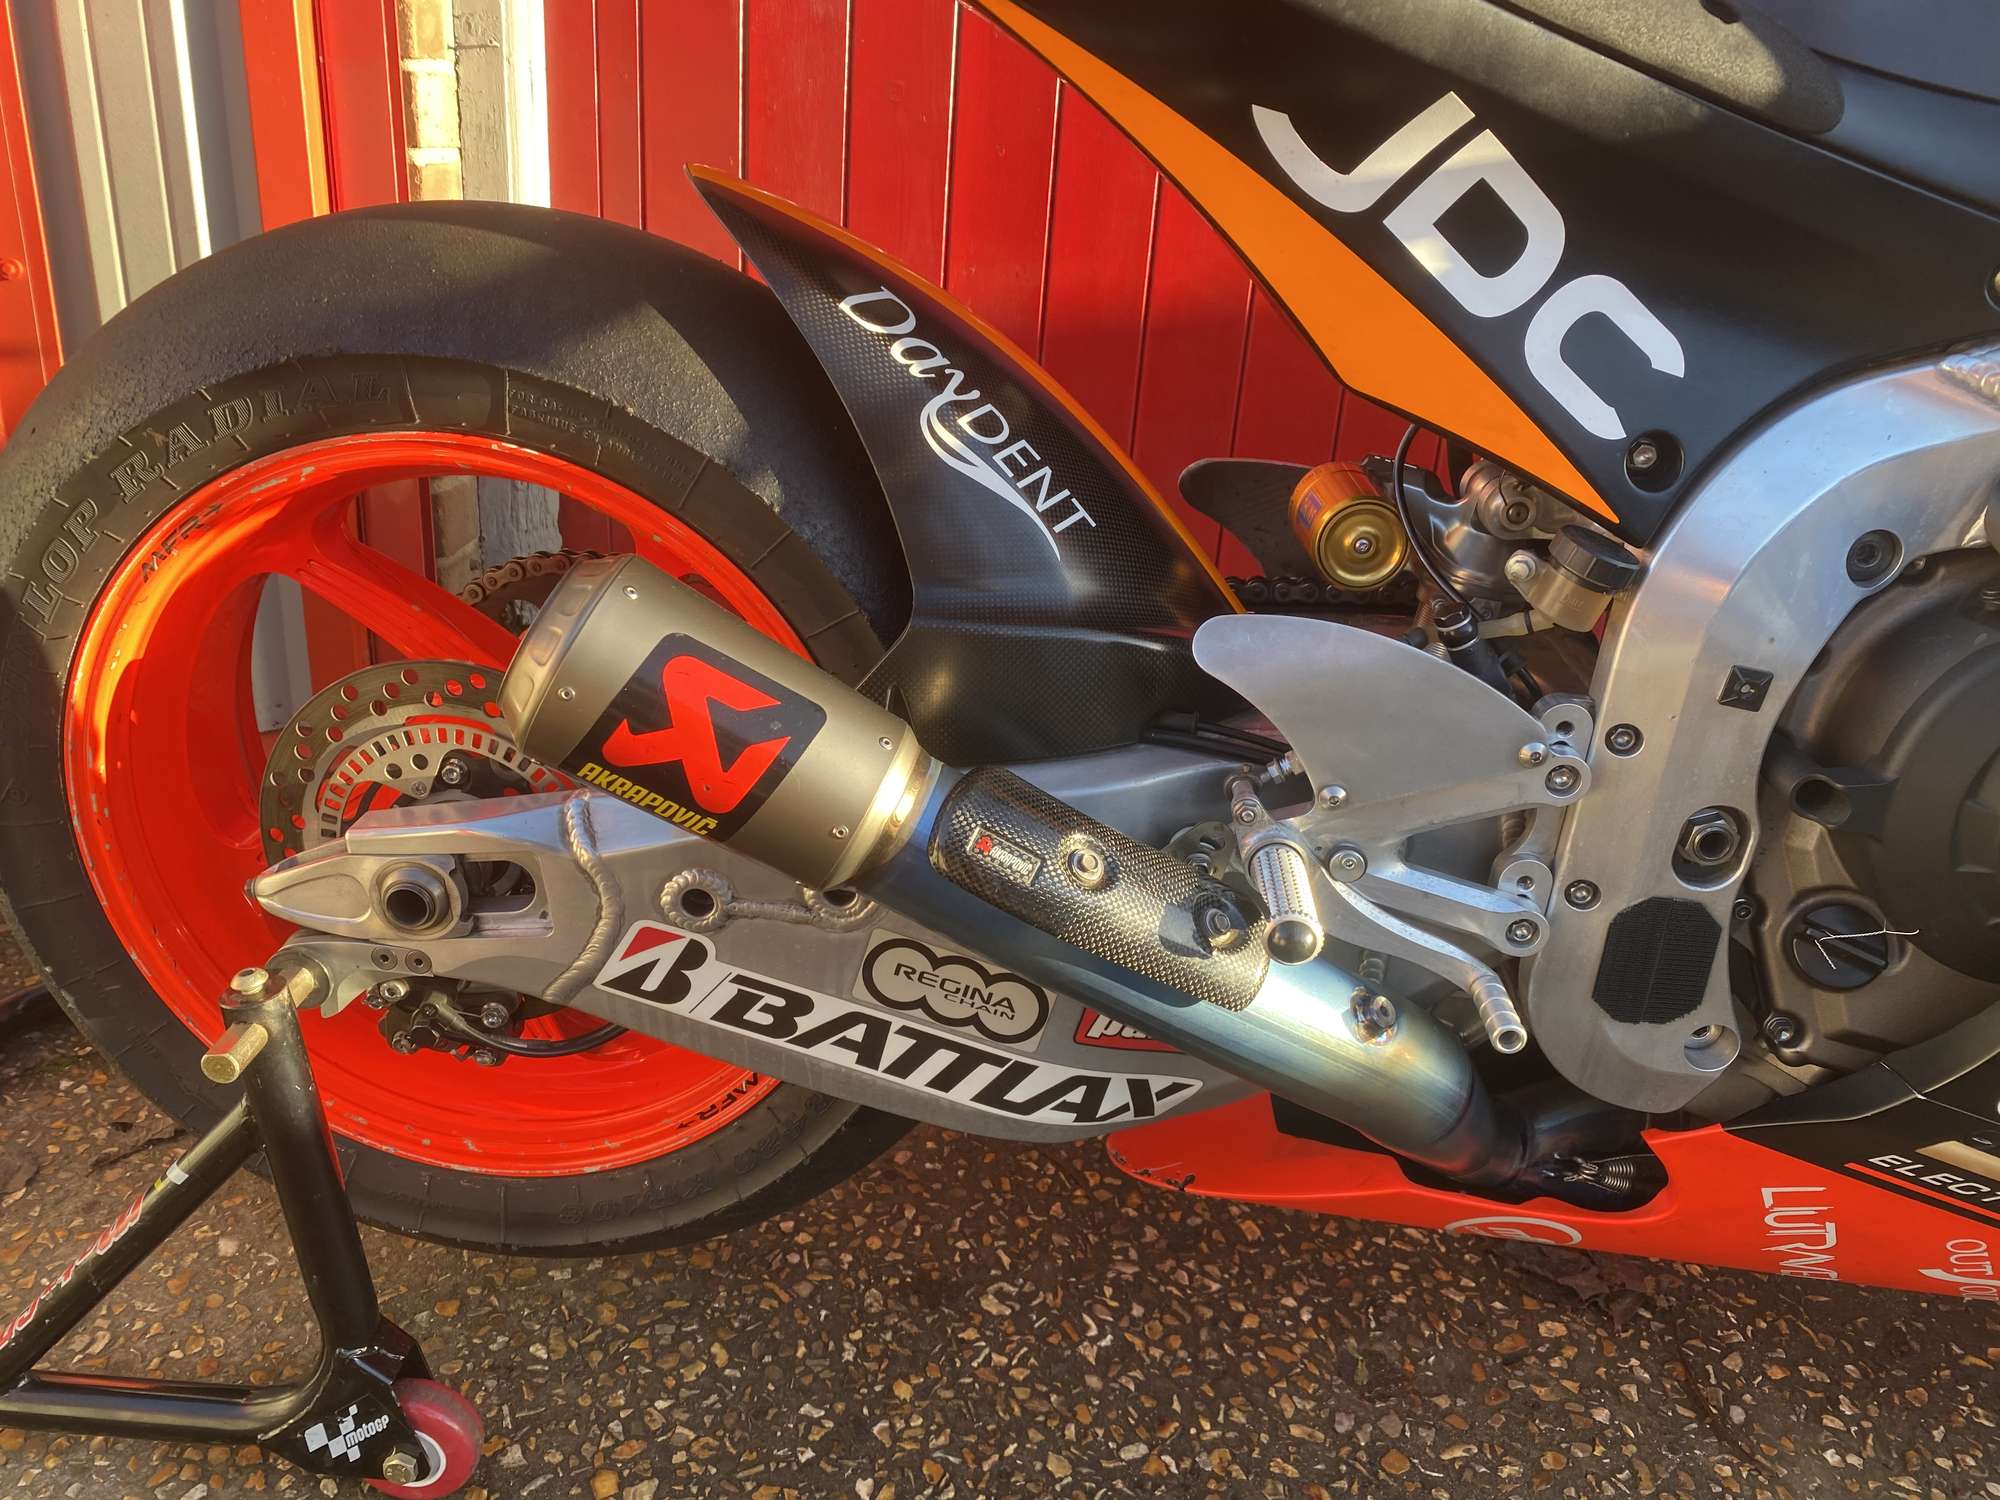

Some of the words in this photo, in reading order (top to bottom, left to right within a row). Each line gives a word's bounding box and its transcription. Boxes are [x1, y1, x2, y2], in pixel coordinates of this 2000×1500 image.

[1251, 91, 1685, 440] JDC
[893, 962, 1017, 1014] REGINA
[943, 993, 1016, 1022] CHAIN
[710, 974, 1196, 1123] BATTLAX
